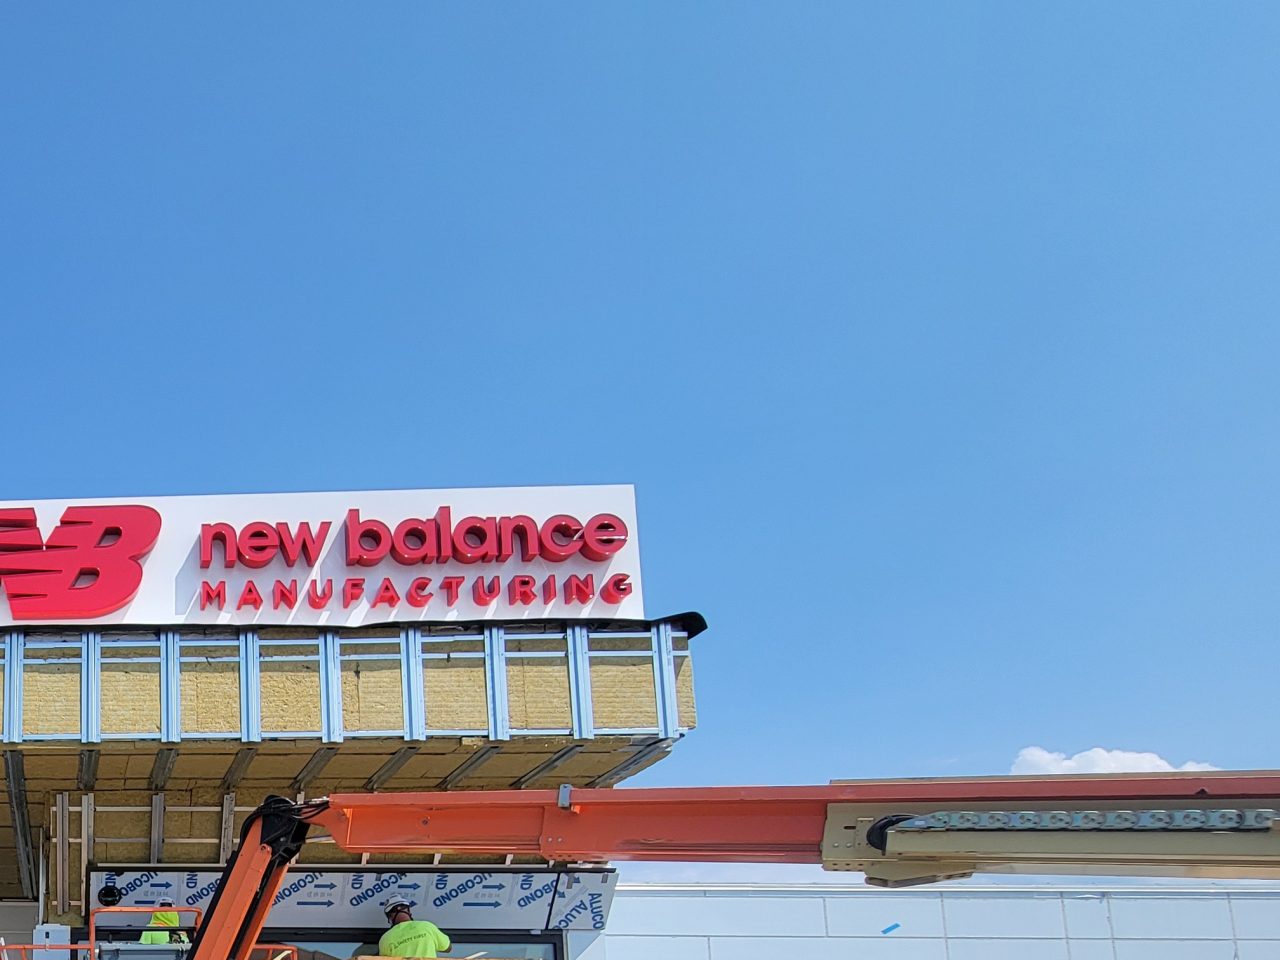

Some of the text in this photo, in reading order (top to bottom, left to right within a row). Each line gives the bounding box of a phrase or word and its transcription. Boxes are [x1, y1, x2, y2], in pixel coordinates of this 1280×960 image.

[200, 506, 629, 568] new balance
[200, 572, 633, 611] MANUFACTURING
[552, 900, 588, 929] ALUC
